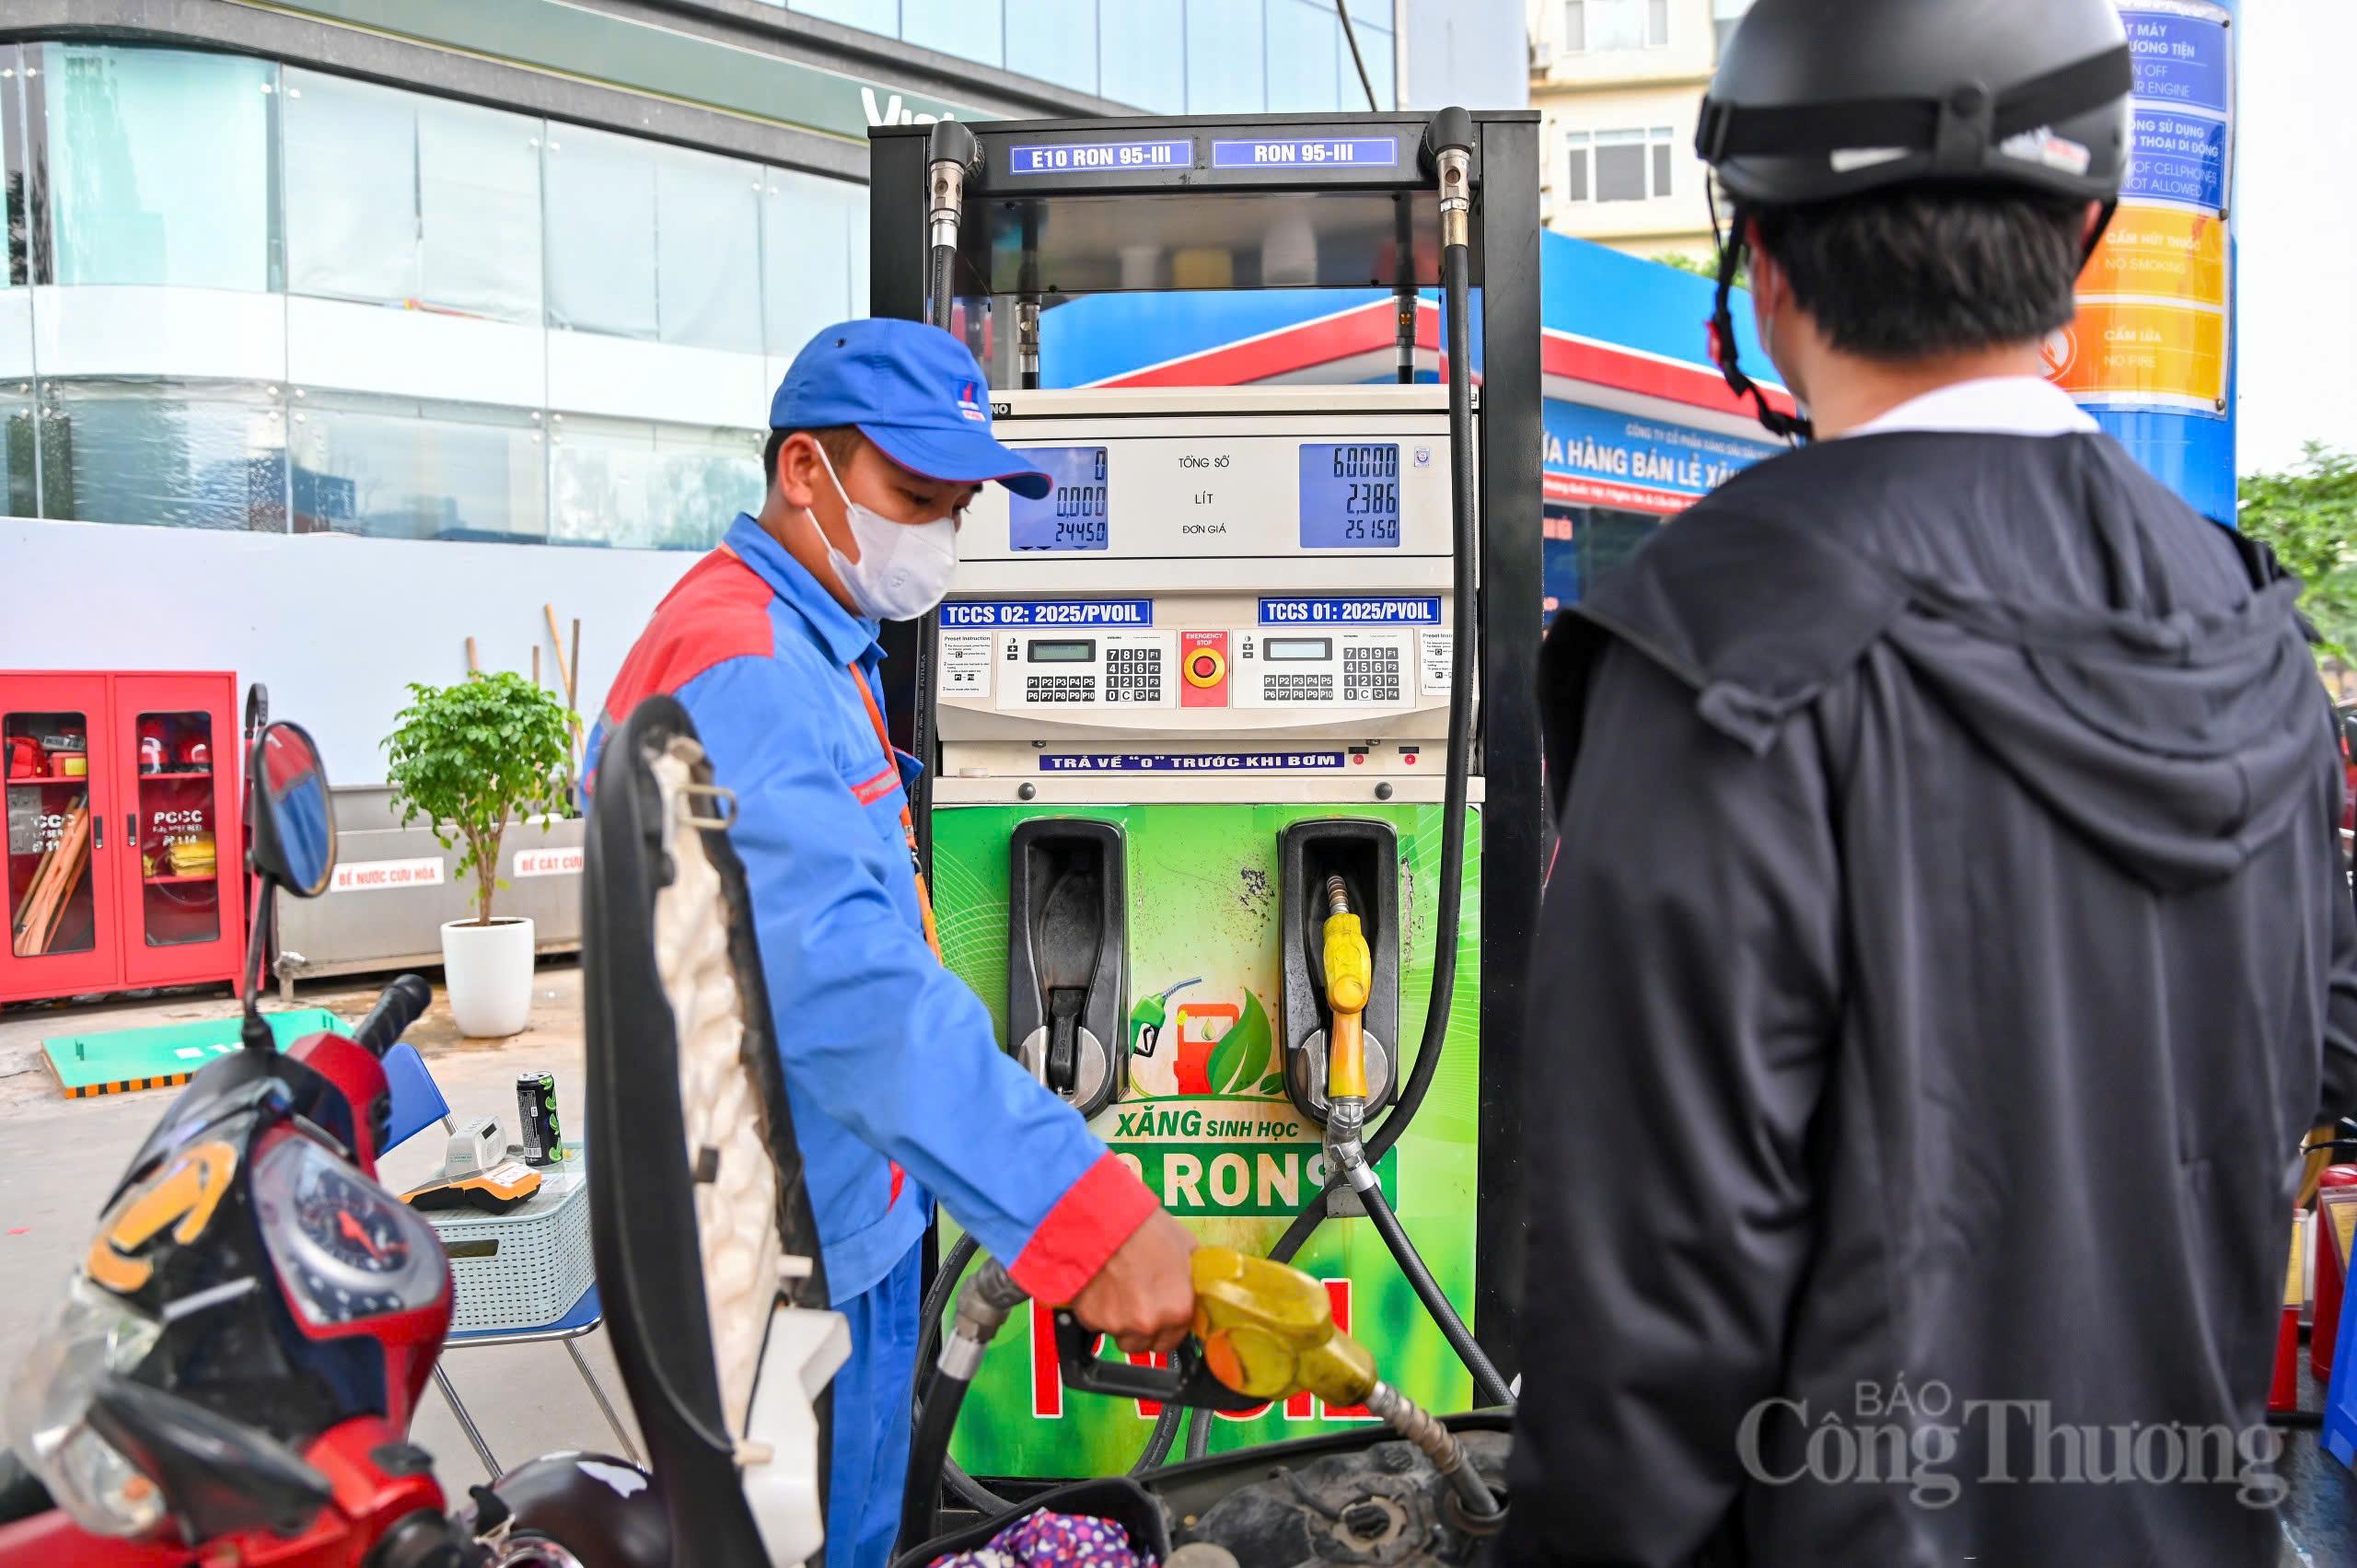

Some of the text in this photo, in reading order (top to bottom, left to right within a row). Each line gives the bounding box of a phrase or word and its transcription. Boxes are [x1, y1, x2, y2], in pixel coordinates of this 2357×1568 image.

[2137, 22, 2167, 38] MÁY
[2172, 41, 2196, 60] TIỆN
[2145, 64, 2169, 77] OFF
[2148, 81, 2191, 98] ENGINE
[2176, 122, 2205, 140] DỤNG
[2140, 135, 2177, 151] THOẠI
[2178, 139, 2190, 152] DI
[1032, 145, 1171, 168] E10 RON 95-III
[1255, 143, 1353, 162] RON 95-III
[2154, 161, 2218, 184] CELLPHONES
[2151, 178, 2203, 198] ALLOWED
[2107, 257, 2127, 270] NO
[1095, 451, 1107, 481] 0
[1178, 455, 1230, 468] TỔNG SỐ
[1334, 447, 1397, 478] 60000
[1568, 435, 1629, 476] HÀNG
[1632, 447, 1674, 483] BÁN
[1195, 490, 1213, 505] LÍT
[1347, 483, 1397, 516] 2,386
[1055, 522, 1106, 542] 24450
[1182, 522, 1227, 534] ĐƠN GIÁ
[1346, 519, 1397, 539] 25150
[946, 603, 1142, 624] TCCS 02: 2025/PVOIL
[1267, 601, 1432, 621] TCCS 01: 2025/PVOIL
[1109, 650, 1159, 659] 7 8 9 F1
[1346, 649, 1353, 658] 7
[1360, 649, 1368, 658] 8
[1374, 649, 1382, 658] 9
[1109, 664, 1159, 673] 4 5 6 F2
[1346, 663, 1353, 672] 4
[1361, 663, 1368, 672] 5
[1375, 663, 1382, 672] 6
[1028, 678, 1095, 687] P1 P2 P3 P4 P5
[1109, 677, 1159, 687] 1 2 3 F3
[1264, 677, 1332, 685] P1 P2 P3 P4 P5
[1347, 676, 1398, 686] 1 2 3 F3
[1028, 692, 1039, 701] P6
[1041, 692, 1052, 701] P7
[1121, 691, 1131, 701] C
[1264, 690, 1333, 699] P6 P7 P8 P9 P10
[1361, 689, 1369, 699] C
[1388, 691, 1398, 699] F4
[1051, 755, 1092, 768] TRẢ
[1097, 755, 1122, 768] VỀ
[1171, 755, 1240, 768] TRƯỚC
[1246, 756, 1282, 767] KHI
[1287, 754, 1336, 766] BƠM
[1114, 1105, 1299, 1142] XĂNG SINH HỌC
[1163, 1153, 1299, 1207] RON
